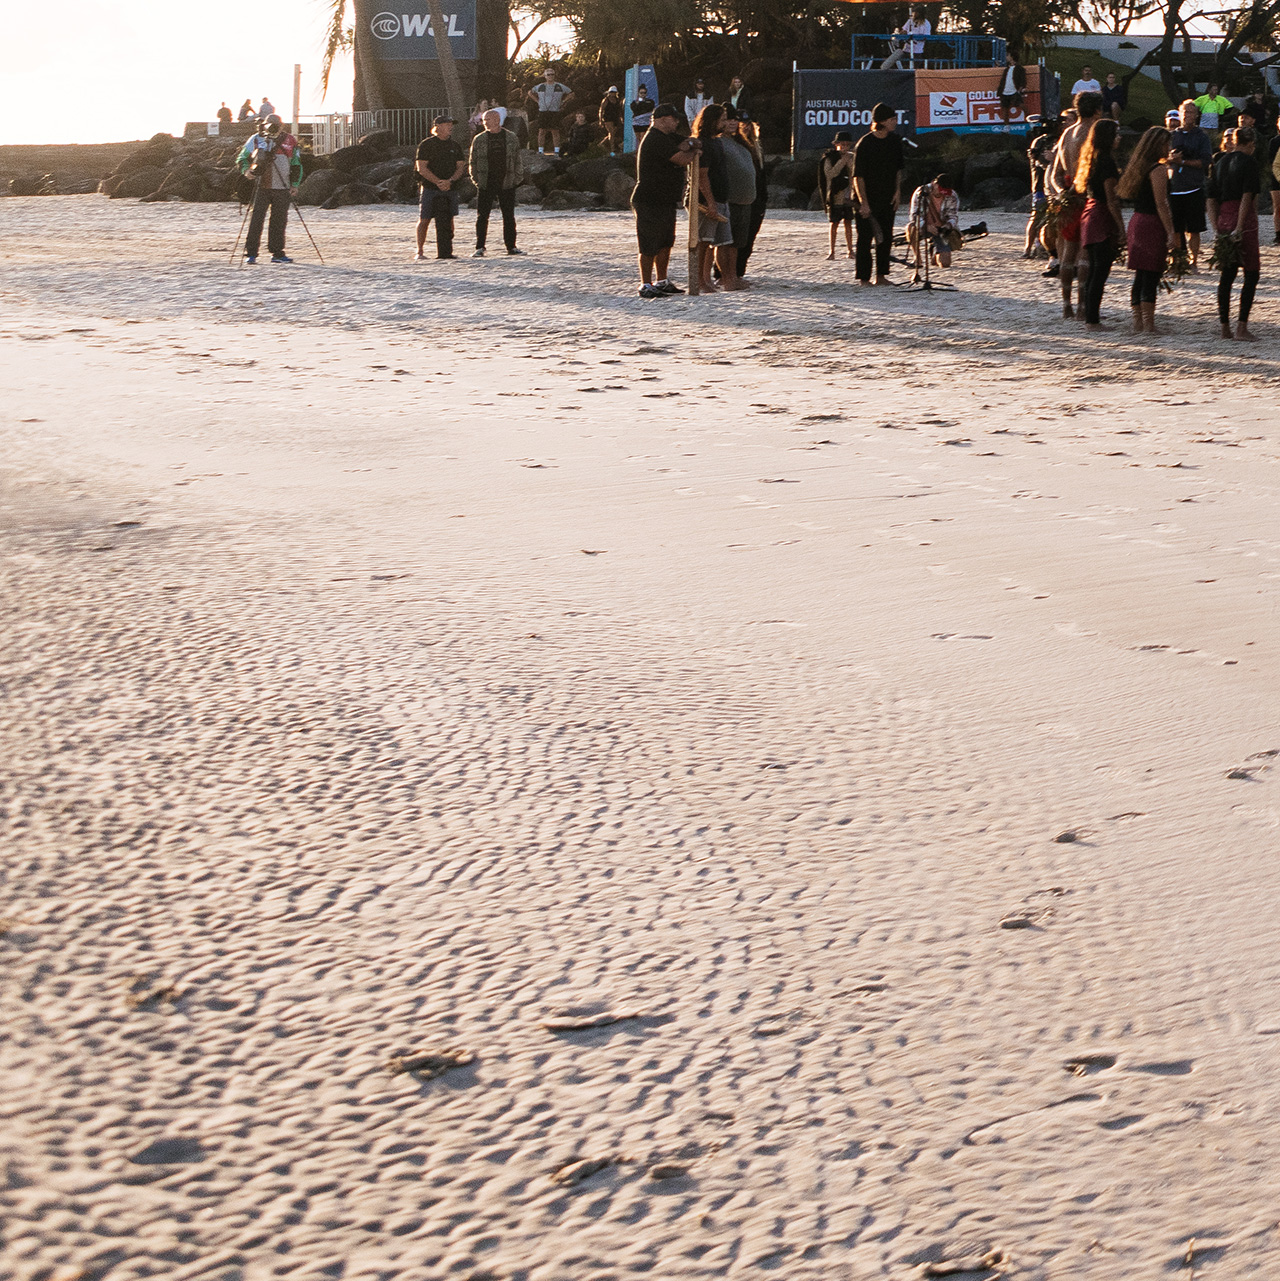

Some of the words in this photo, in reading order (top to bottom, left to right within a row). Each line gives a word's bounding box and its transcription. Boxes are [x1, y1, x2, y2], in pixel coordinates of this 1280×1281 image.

[806, 100, 857, 108] AUSTRALIA'S
[934, 108, 964, 117] boost
[805, 109, 909, 126] GOLDCOT.
